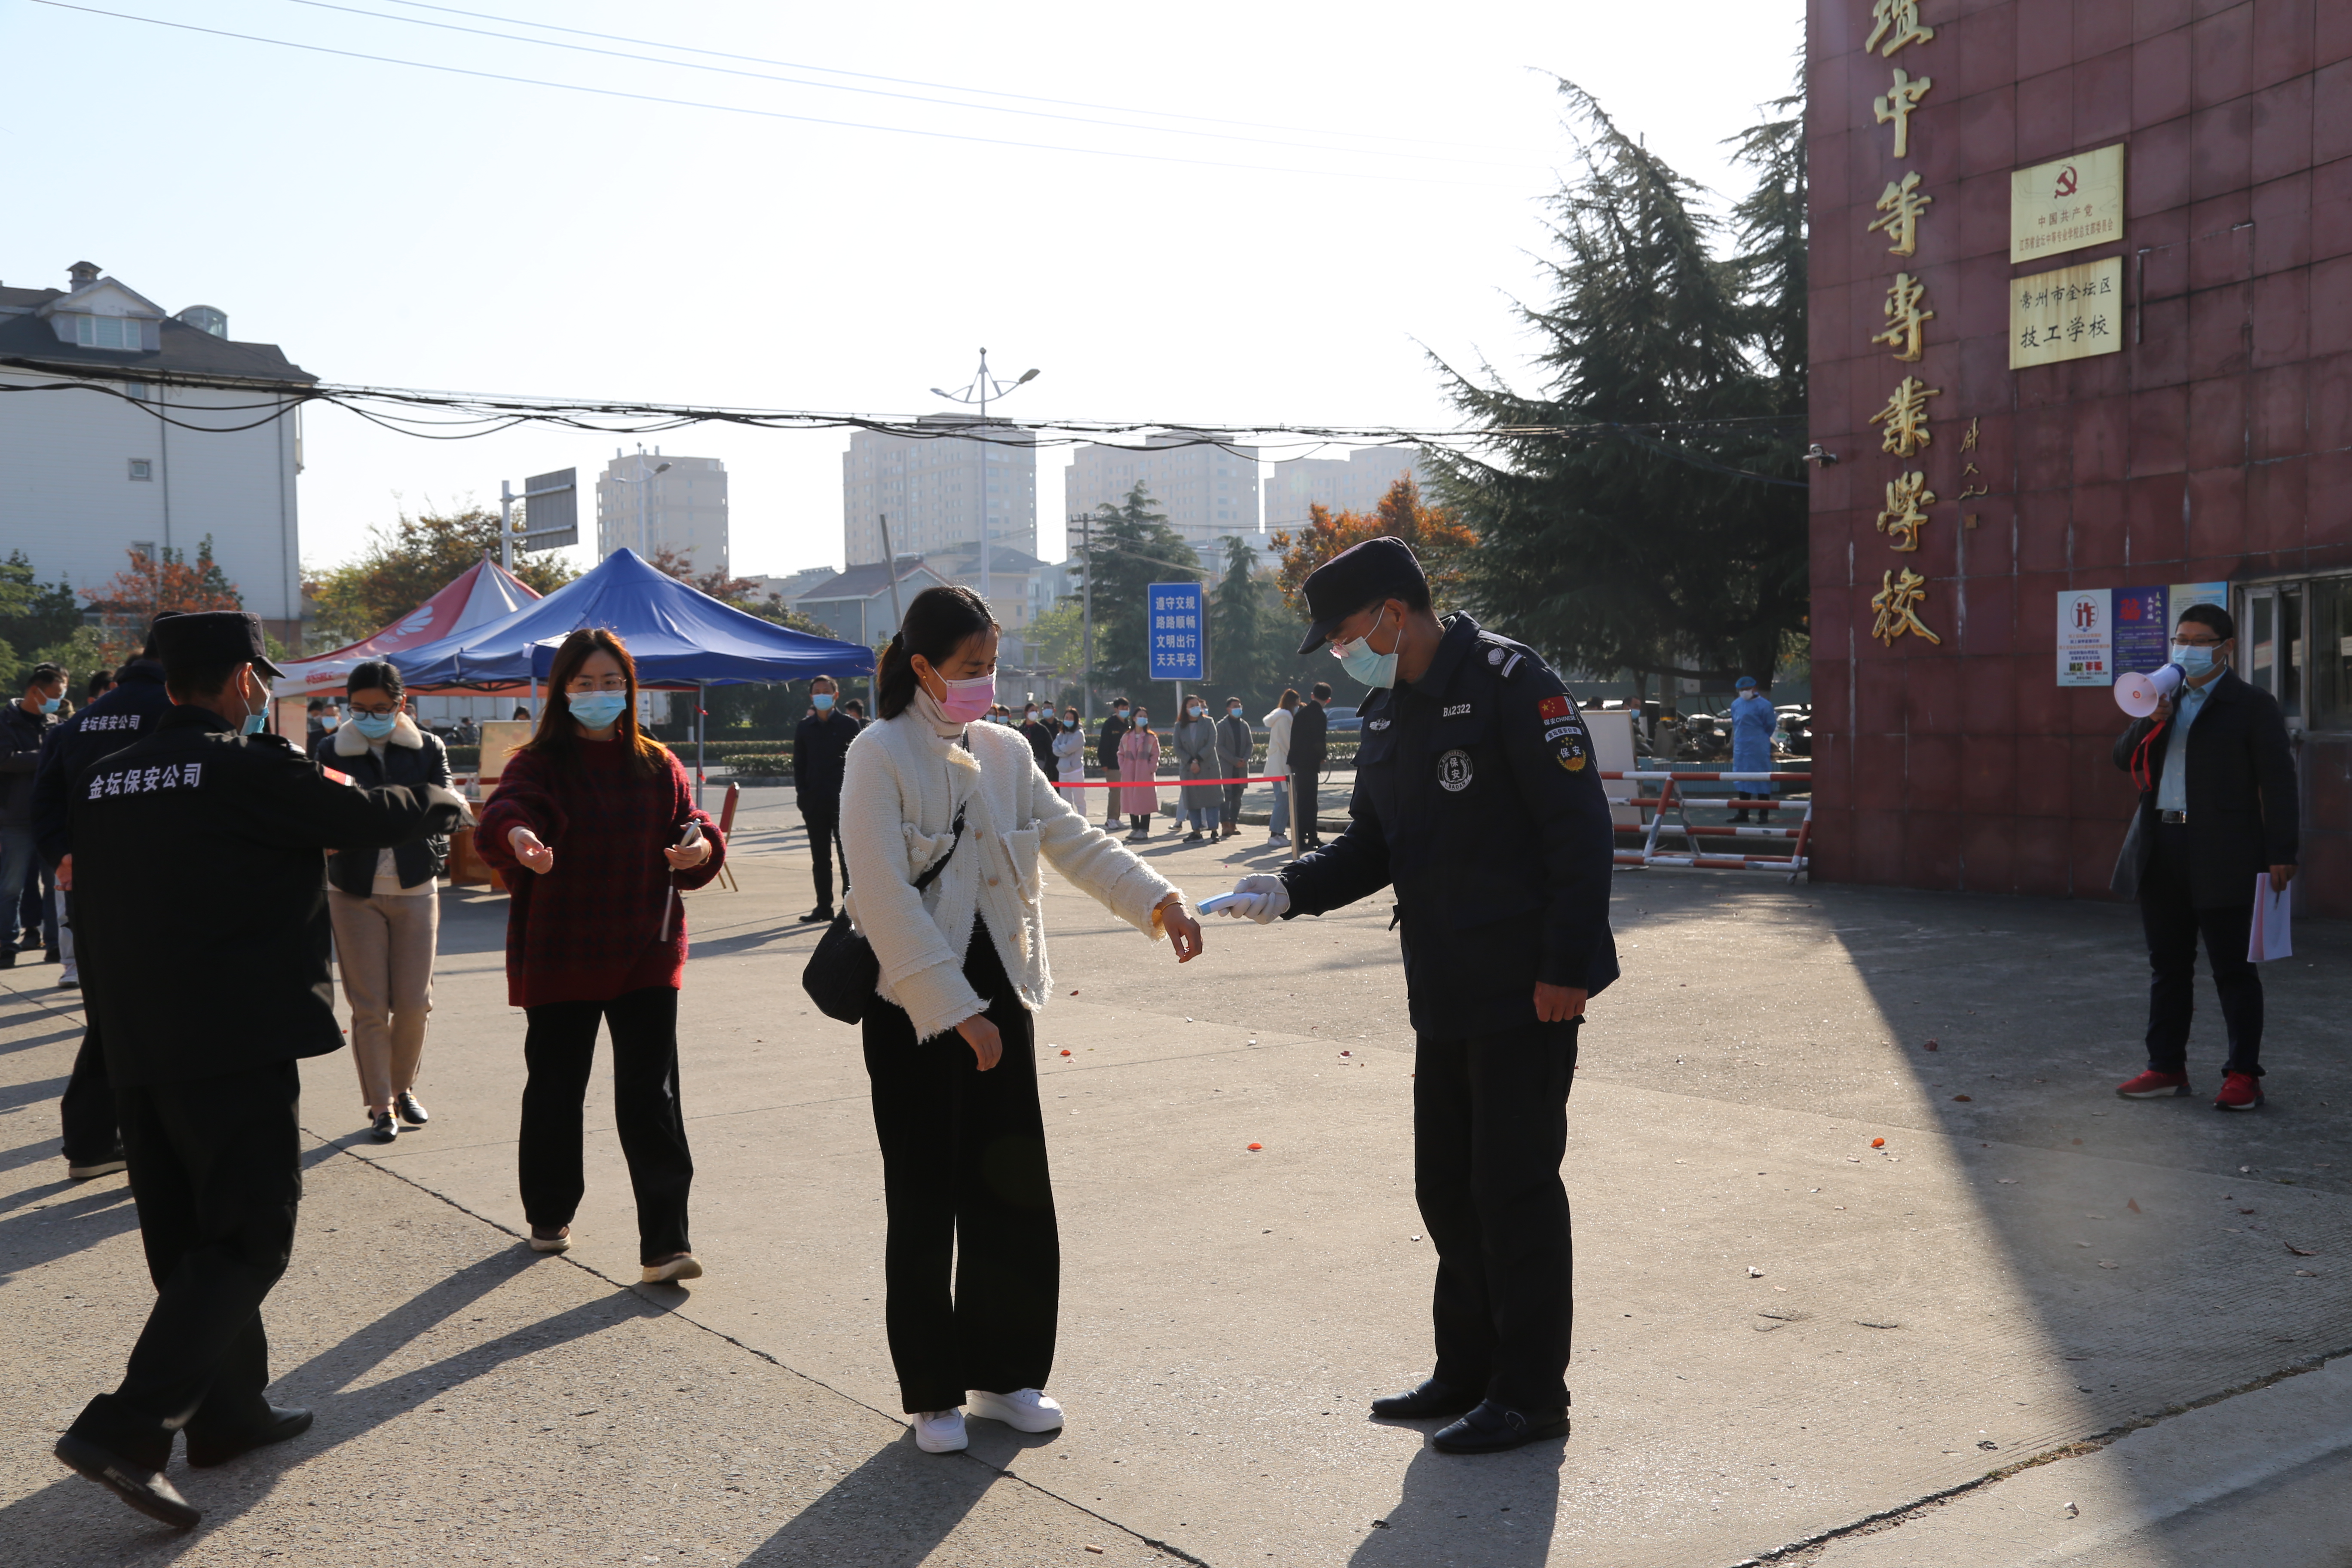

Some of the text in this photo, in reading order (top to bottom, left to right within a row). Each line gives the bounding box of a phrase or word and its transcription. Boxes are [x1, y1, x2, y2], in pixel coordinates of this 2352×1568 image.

[2038, 204, 2093, 228] 中国共产党
[2019, 217, 2113, 251] 江苏省金坛中等专业学校总支部委员会
[2020, 277, 2111, 312] 常州市金坛区
[2021, 315, 2110, 348] 技工学校
[1156, 596, 1195, 610] 遵守交规
[1156, 616, 1196, 629] 路路顺畅
[2076, 603, 2096, 628] 诈
[1156, 634, 1196, 648] 文明出行
[1157, 653, 1196, 667] 天天平安
[1443, 704, 1471, 717] BA2322
[80, 715, 141, 732] 金坛保安公司
[1548, 727, 1578, 738] 金坛保安公司
[1560, 746, 1581, 758] 保安
[1450, 757, 1460, 779] 保安
[88, 763, 202, 799] 金坛保安公司
[1448, 781, 1466, 790] BAOAN
